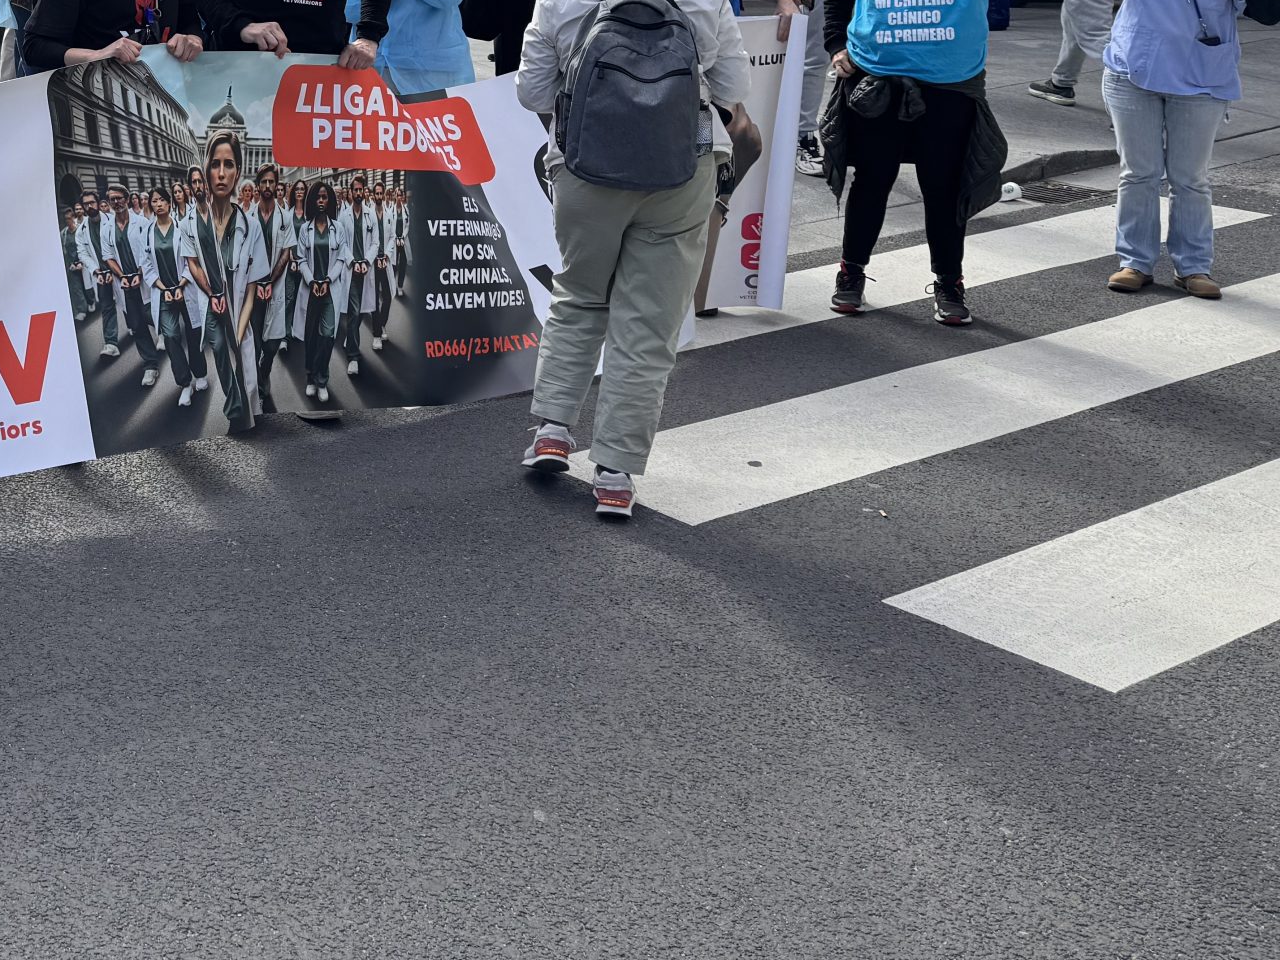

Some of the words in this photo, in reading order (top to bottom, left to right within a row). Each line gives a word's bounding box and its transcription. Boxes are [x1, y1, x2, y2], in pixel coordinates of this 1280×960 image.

[888, 10, 941, 25] CLÍNICO
[876, 30, 892, 44] VA
[894, 28, 955, 43] PRIMERO
[296, 83, 411, 118] LLIGAT
[312, 118, 371, 150] PEL
[462, 196, 479, 213] ELS
[452, 244, 473, 260] NO
[477, 244, 497, 260] SOM
[440, 268, 513, 285] CRIMINALS,
[426, 292, 486, 310] SALVEM
[488, 290, 525, 307] VIDES!
[426, 338, 490, 361] RD666/23
[494, 332, 540, 353] MATA!
